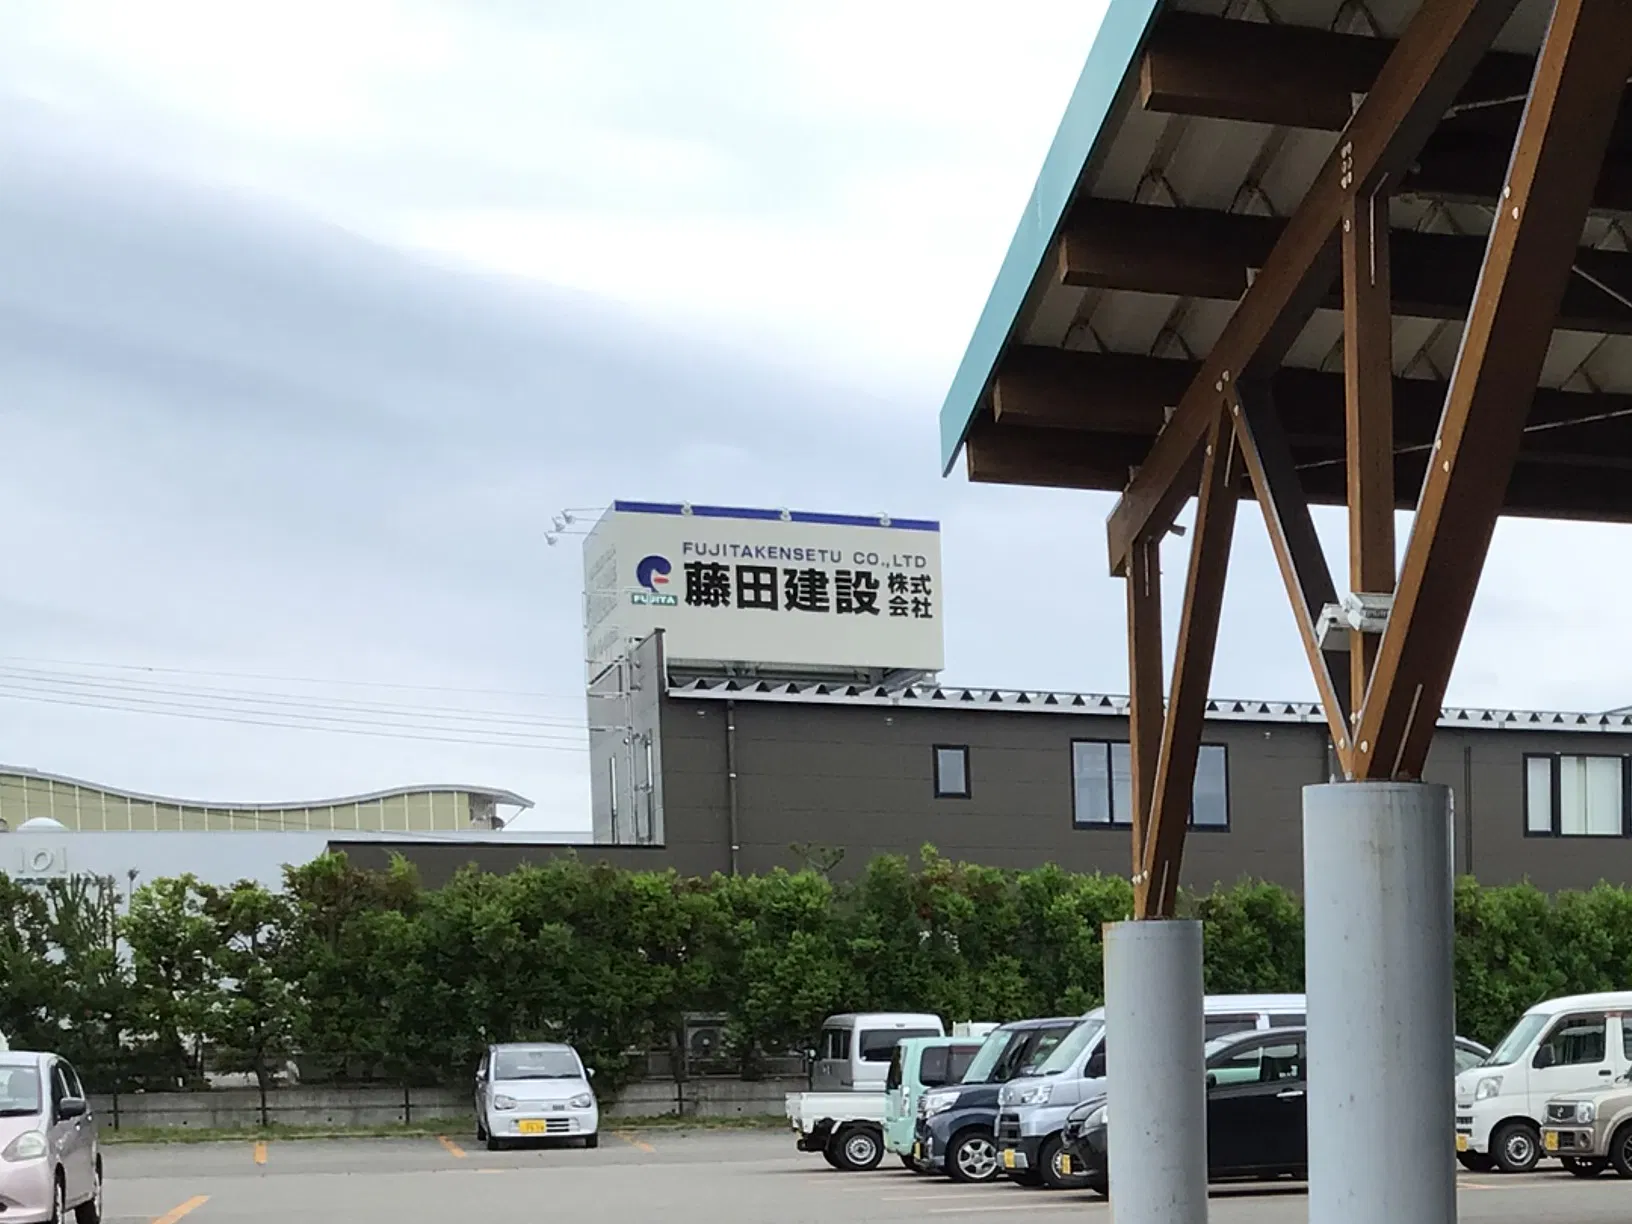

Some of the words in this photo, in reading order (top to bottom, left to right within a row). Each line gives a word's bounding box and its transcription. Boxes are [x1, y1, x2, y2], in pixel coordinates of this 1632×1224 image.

[683, 541, 842, 563] FUJITAKENSETU
[683, 561, 881, 615] 藤田建設
[888, 572, 932, 595] 株式
[633, 594, 676, 605] FUJITA
[889, 595, 933, 618] 会社
